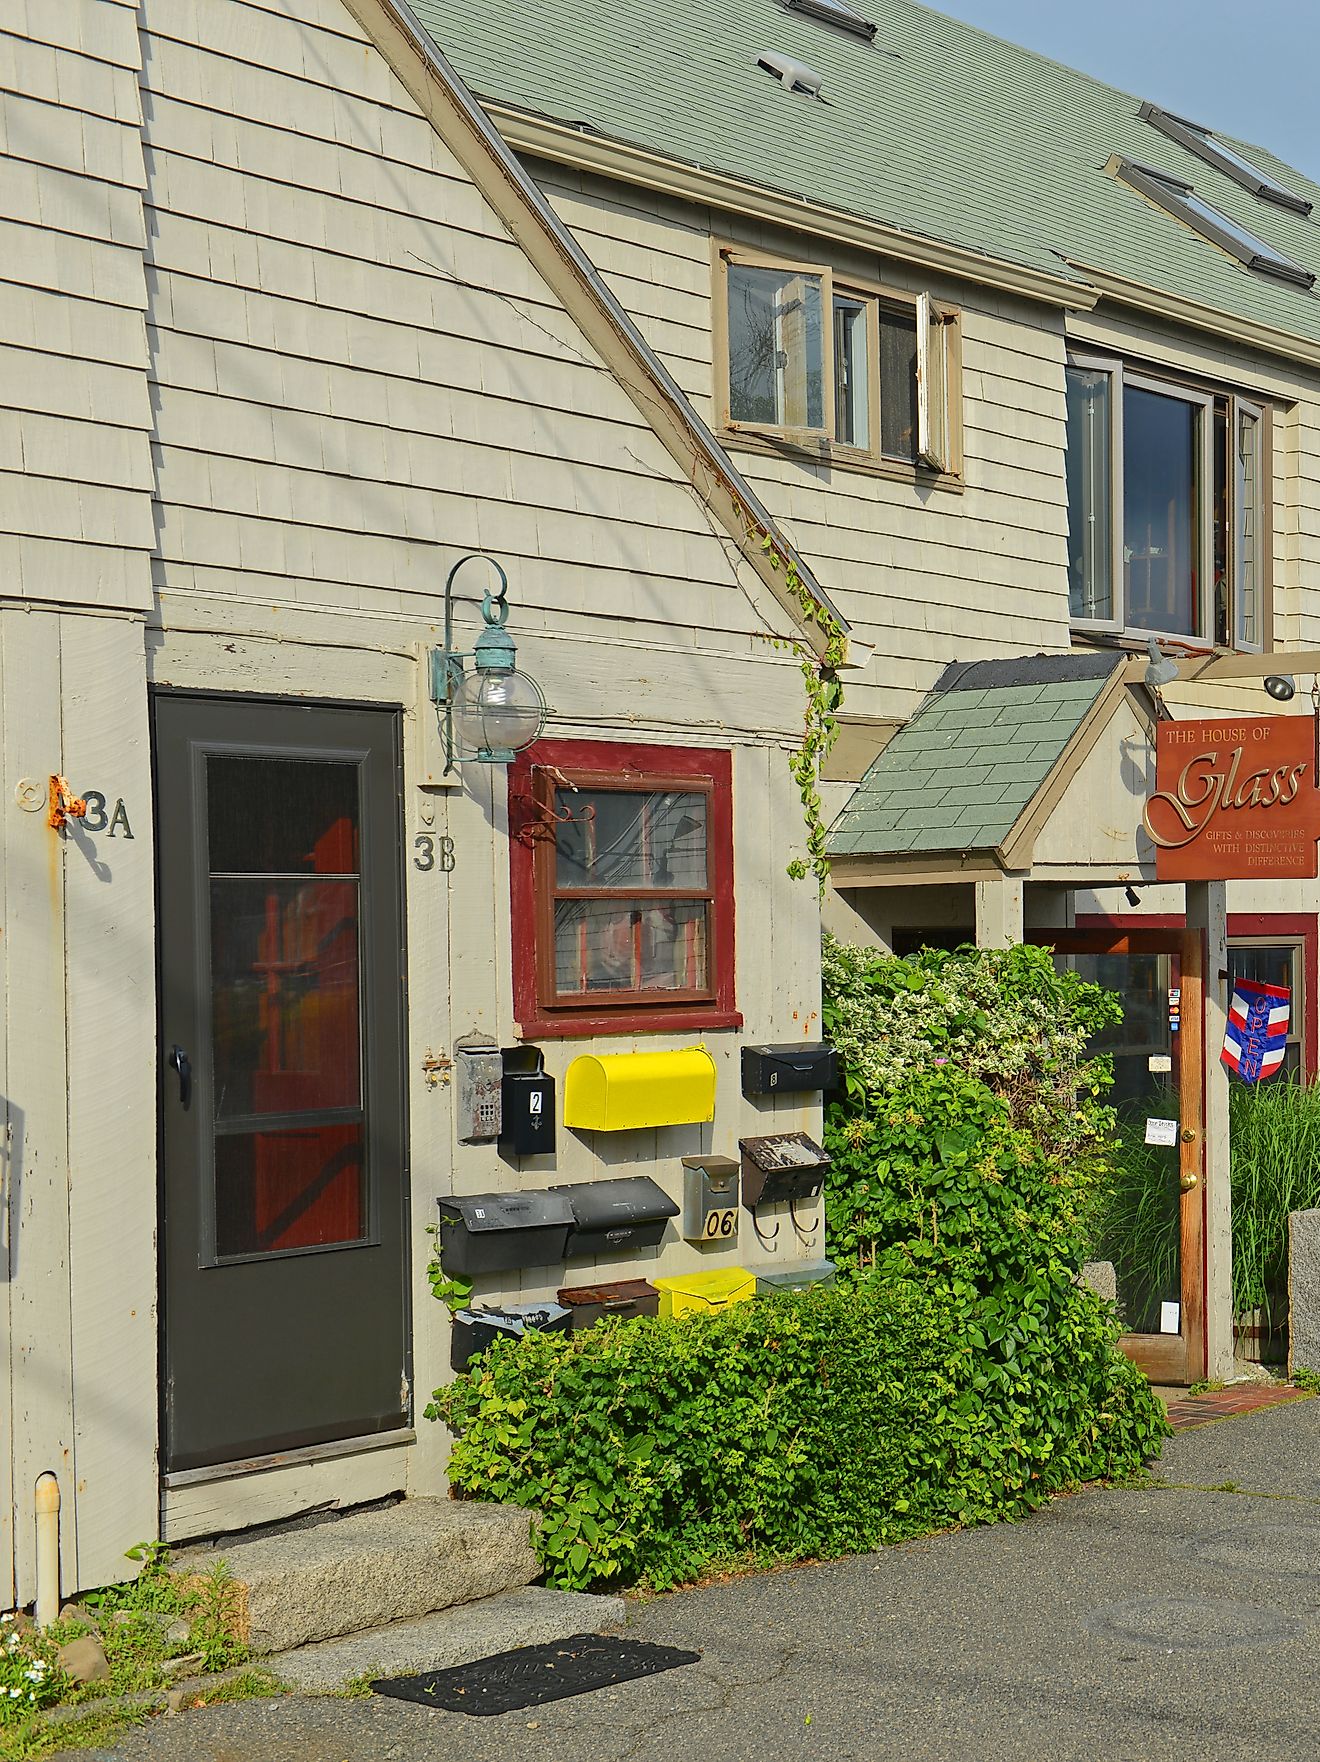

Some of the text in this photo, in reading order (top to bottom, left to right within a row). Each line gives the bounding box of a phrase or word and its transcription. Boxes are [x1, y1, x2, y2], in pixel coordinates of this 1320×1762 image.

[1166, 727, 1271, 744] THE HOUSE OF
[1142, 746, 1308, 848] Glass
[1205, 830, 1232, 841] GIFTS
[1235, 831, 1242, 840] &
[413, 835, 456, 872] 3B
[1213, 843, 1240, 853] WITH
[1248, 855, 1305, 866] DIFFERENCE
[1244, 996, 1267, 1078] OPEN
[532, 1093, 540, 1112] 2
[706, 1210, 735, 1237] 06
